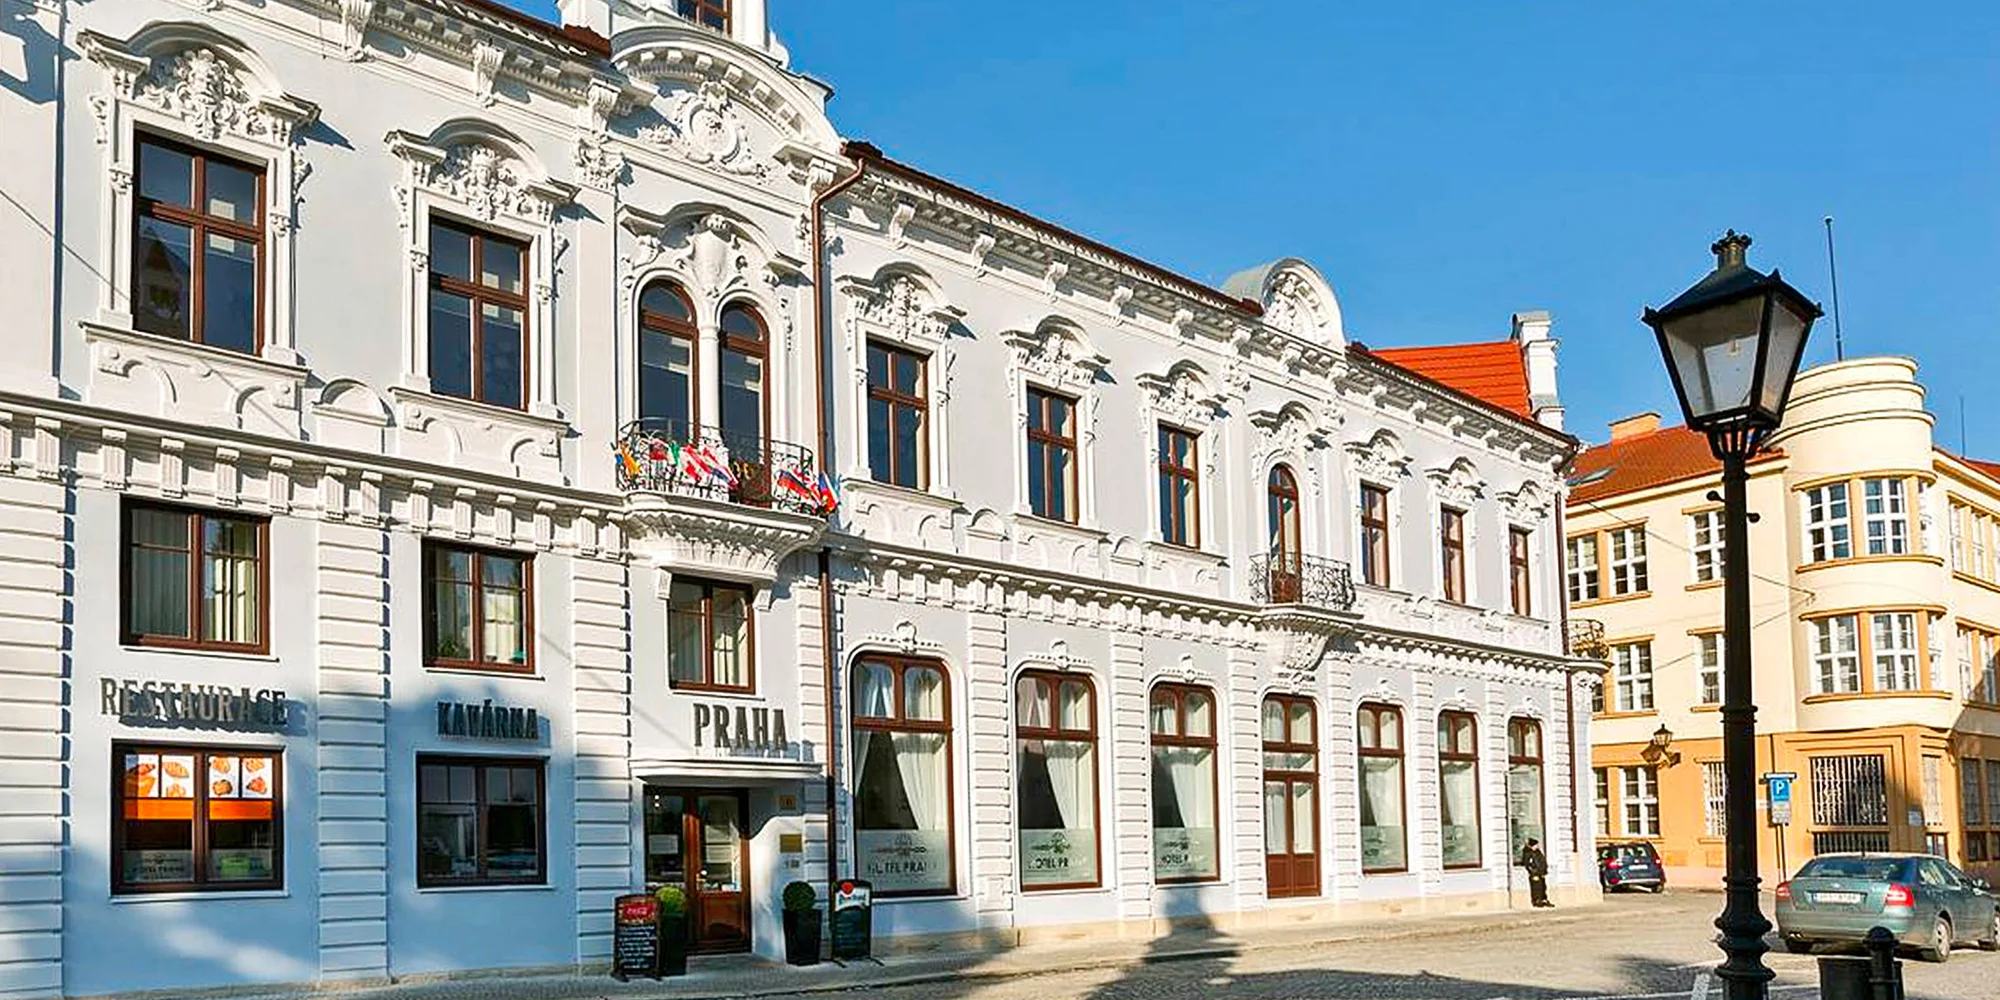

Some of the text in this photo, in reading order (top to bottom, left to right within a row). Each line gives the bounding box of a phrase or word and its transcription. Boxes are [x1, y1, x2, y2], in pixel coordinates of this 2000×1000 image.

[100, 677, 288, 726] RESTAURACE
[437, 698, 539, 740] KAVÁRNA
[693, 702, 788, 752] PRAHA
[1776, 780, 1786, 795] P
